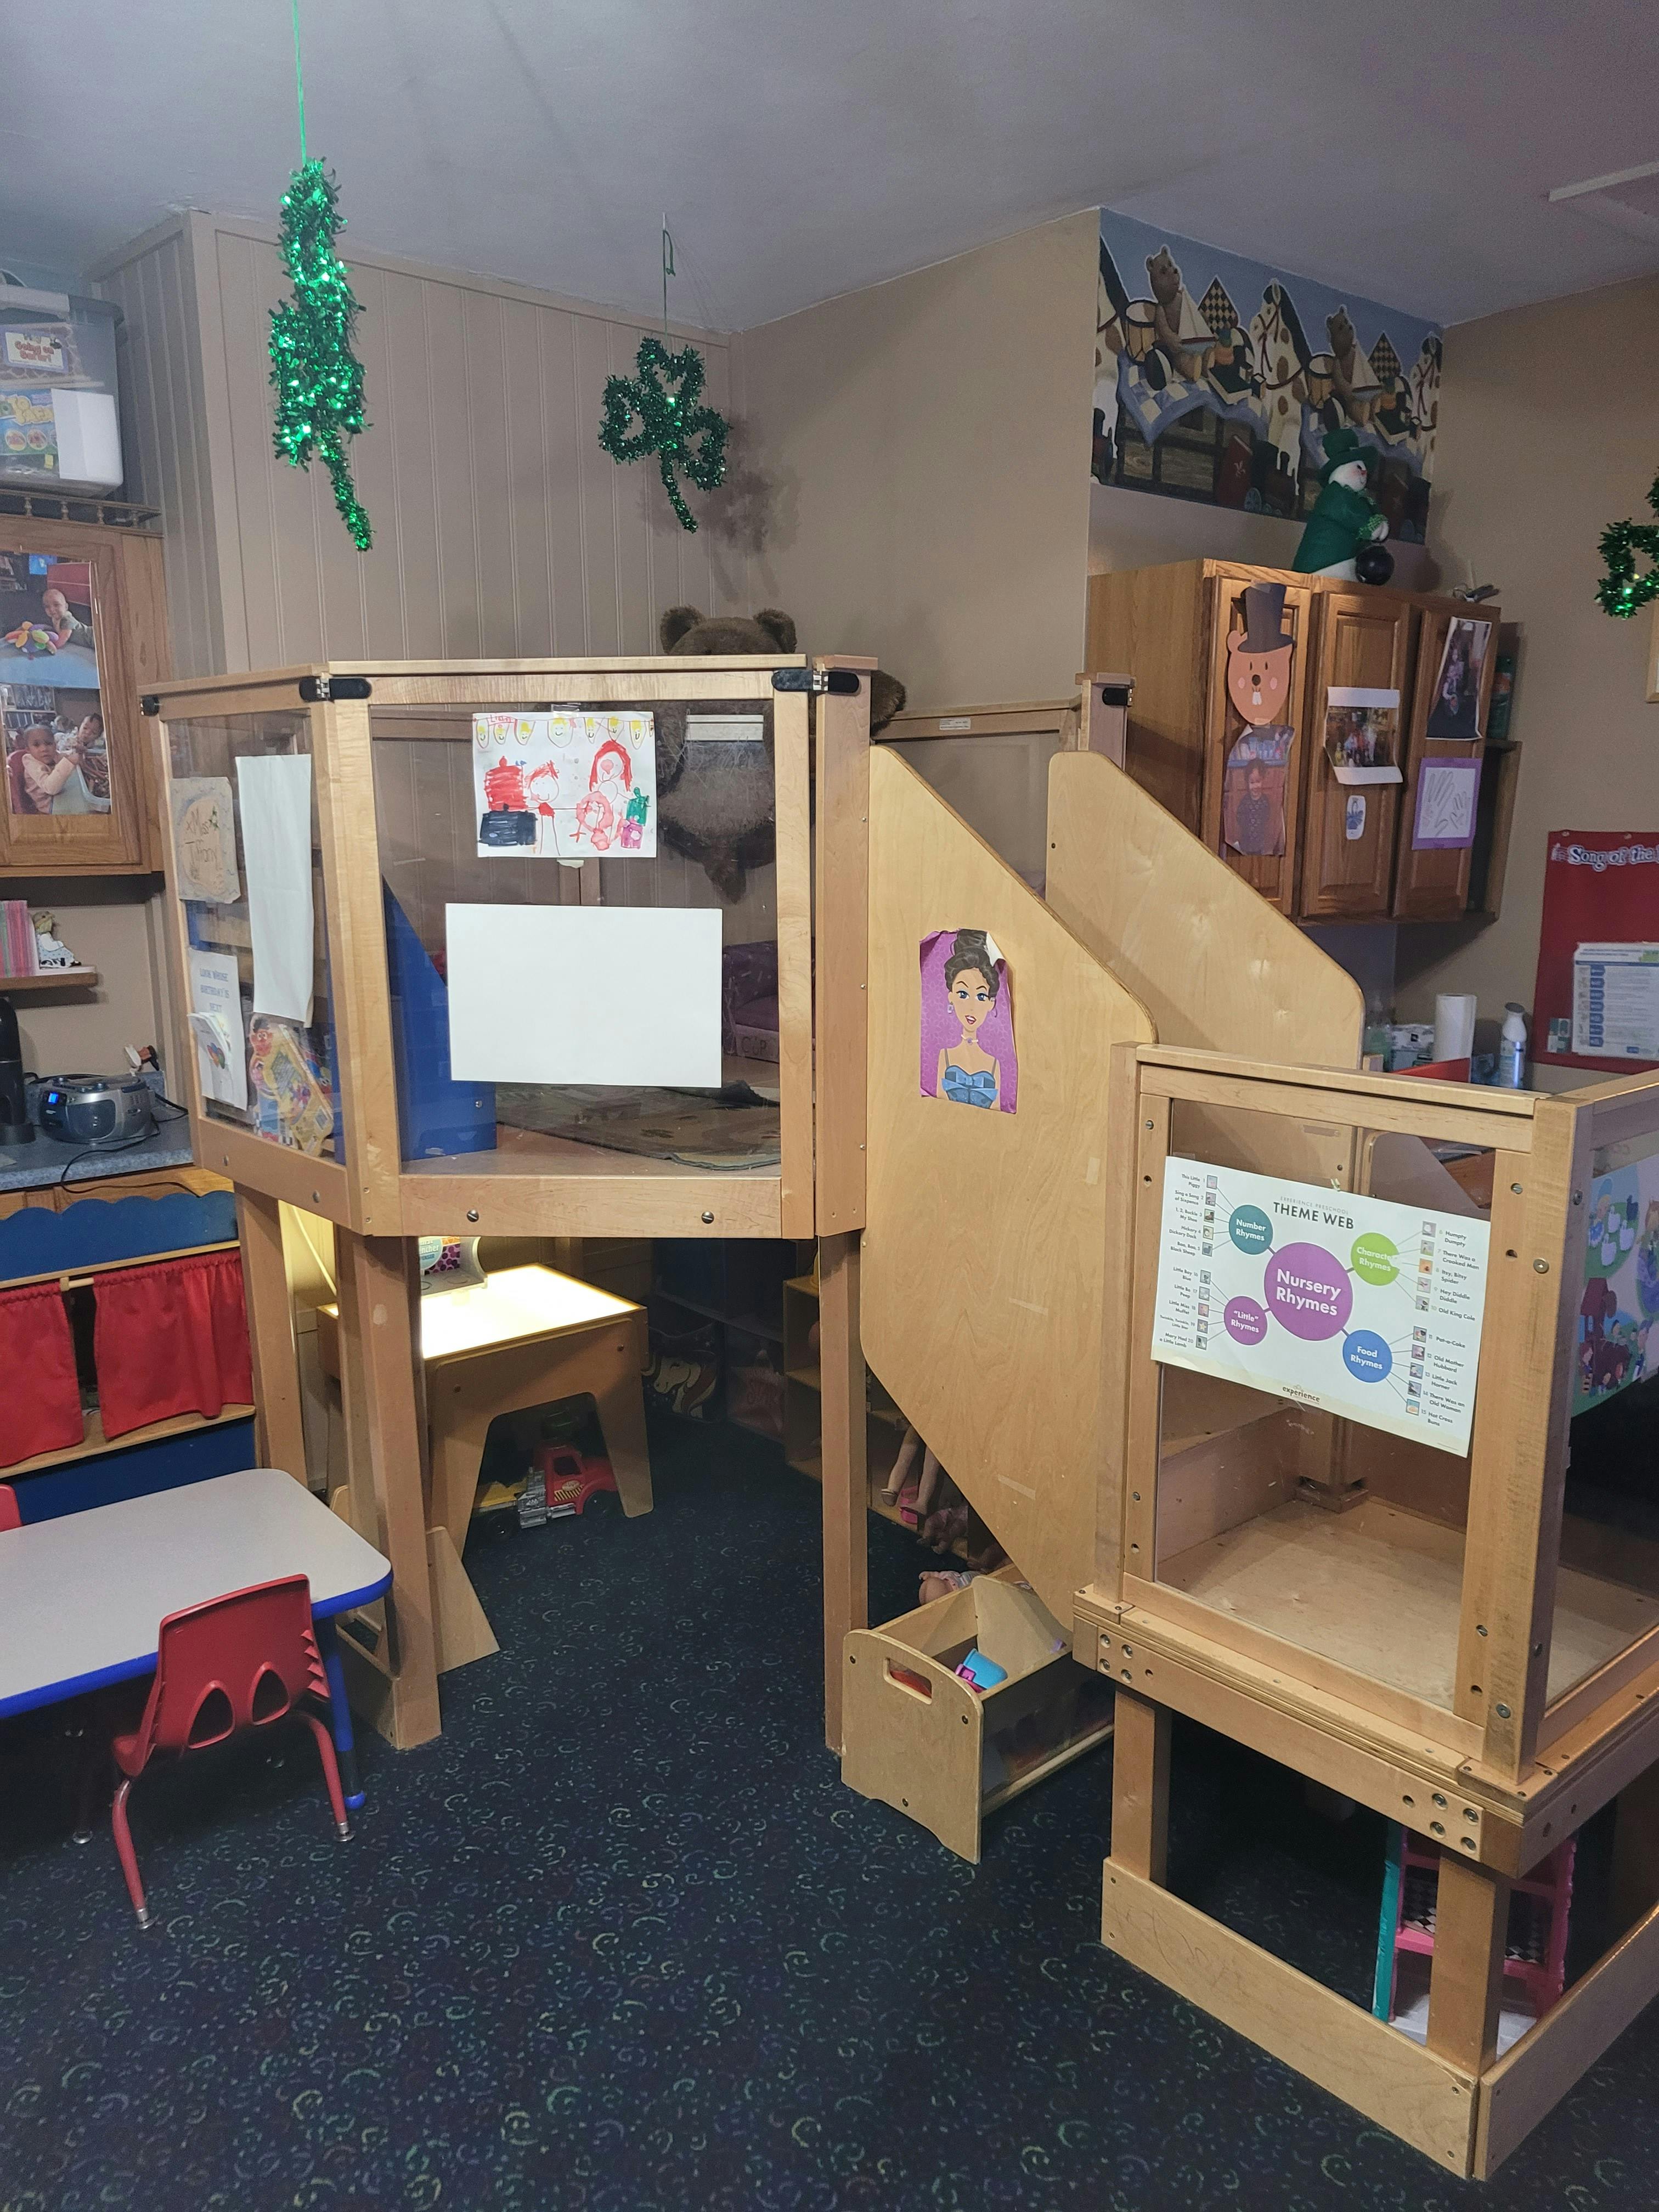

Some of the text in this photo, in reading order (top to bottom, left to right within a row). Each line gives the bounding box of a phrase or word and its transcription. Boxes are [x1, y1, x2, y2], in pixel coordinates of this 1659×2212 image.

[1568, 846, 1606, 871] Song
[1608, 847, 1627, 864] of
[1630, 845, 1653, 864] the
[1180, 1197, 1199, 1205] Sixpence
[1280, 1196, 1348, 1215] EXPERIENCE PRESCHOOL
[1273, 1201, 1354, 1229] THEME WEB
[1181, 1226, 1197, 1234] Hickory
[1236, 1218, 1266, 1232] Number
[1169, 1229, 1186, 1238] Dickory
[1236, 1228, 1265, 1241] Rhymes
[1445, 1231, 1467, 1240] Humpty
[1444, 1238, 1466, 1248] Dumpty
[1359, 1257, 1391, 1272] Rhymes
[1443, 1257, 1466, 1267] Crooked
[1441, 1277, 1459, 1285] Spider
[1454, 1272, 1467, 1281] Bitsy
[1277, 1268, 1341, 1301] Nursery
[1440, 1296, 1457, 1304] Diddle
[1452, 1291, 1470, 1300] Diddle
[1276, 1286, 1338, 1316] Rhymes
[1175, 1307, 1189, 1315] Muffet
[1449, 1311, 1463, 1319] King
[1231, 1319, 1260, 1333] Rhymes
[1165, 1332, 1177, 1340] Mary
[1436, 1336, 1466, 1348] Pat-a-Cake
[1357, 1346, 1378, 1358] Food
[1351, 1354, 1383, 1370] Rhymes
[1445, 1358, 1465, 1368] Mother
[1434, 1362, 1457, 1373] Hubbard
[1432, 1374, 1445, 1382] Little
[1431, 1381, 1451, 1390] Horner
[1282, 1385, 1320, 1402] experience
[1430, 1392, 1444, 1401] There
[1445, 1397, 1457, 1406] Was
[1441, 1403, 1462, 1414] Woman
